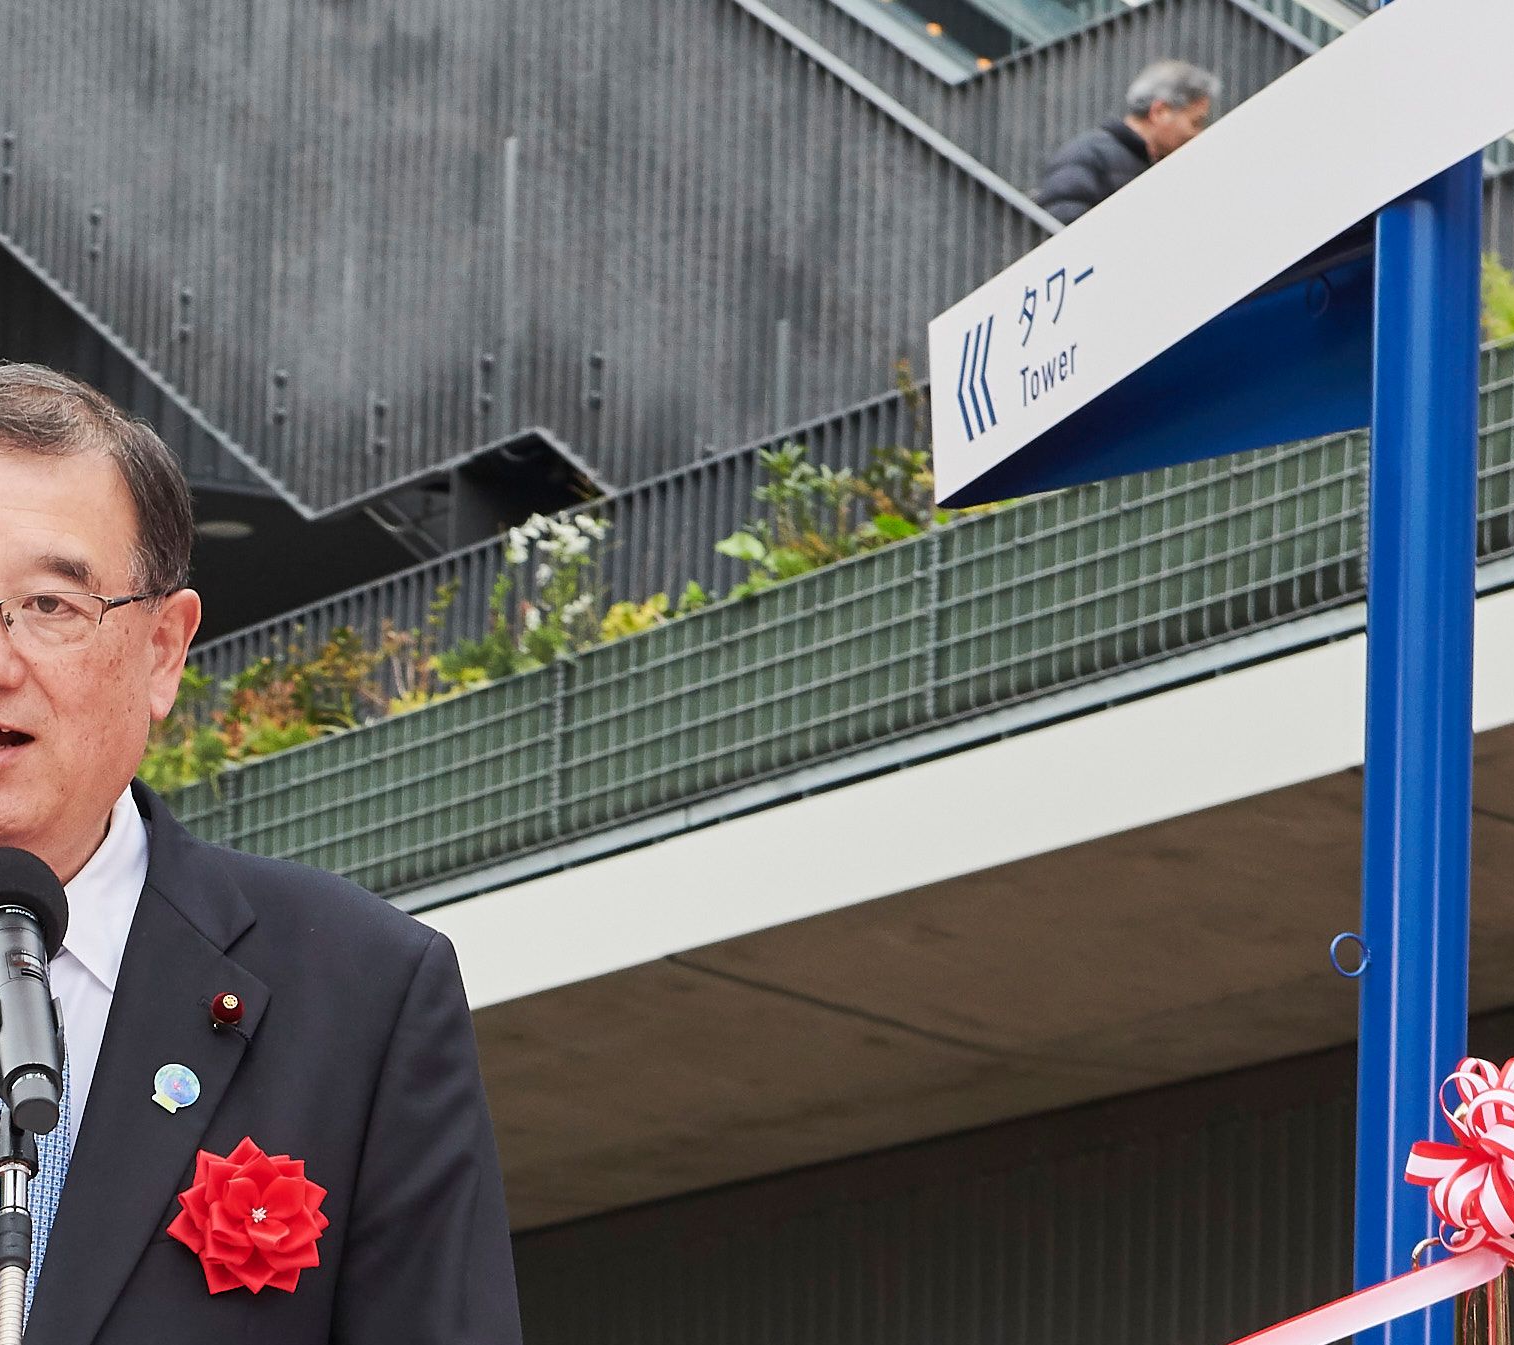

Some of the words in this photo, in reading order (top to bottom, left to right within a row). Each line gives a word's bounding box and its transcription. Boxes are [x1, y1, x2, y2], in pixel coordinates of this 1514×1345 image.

[1019, 265, 1094, 347] タワー
[1020, 342, 1077, 407] Tower
